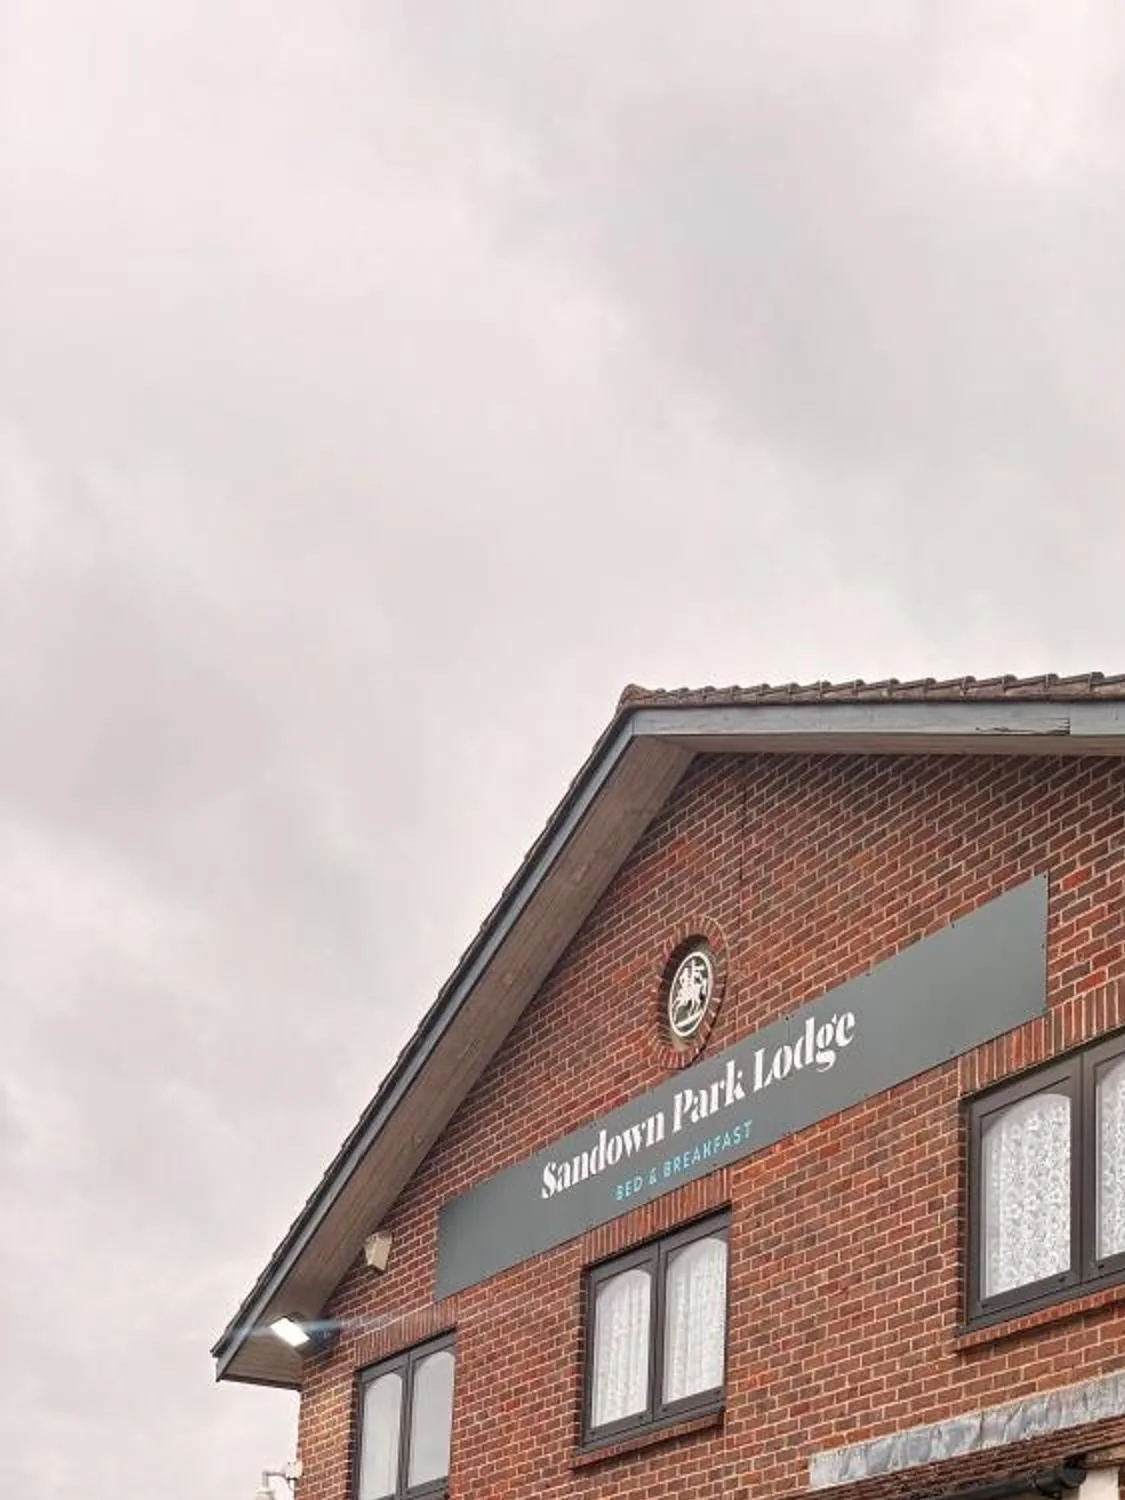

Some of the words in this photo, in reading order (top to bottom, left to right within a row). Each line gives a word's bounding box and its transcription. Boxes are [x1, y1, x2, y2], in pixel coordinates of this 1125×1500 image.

[541, 1111, 665, 1199] Sandown
[672, 1060, 746, 1133] Park
[753, 1011, 856, 1092] Lodge
[616, 1176, 643, 1200] BED
[649, 1167, 657, 1185] &
[663, 1120, 753, 1178] BREAKFAST
